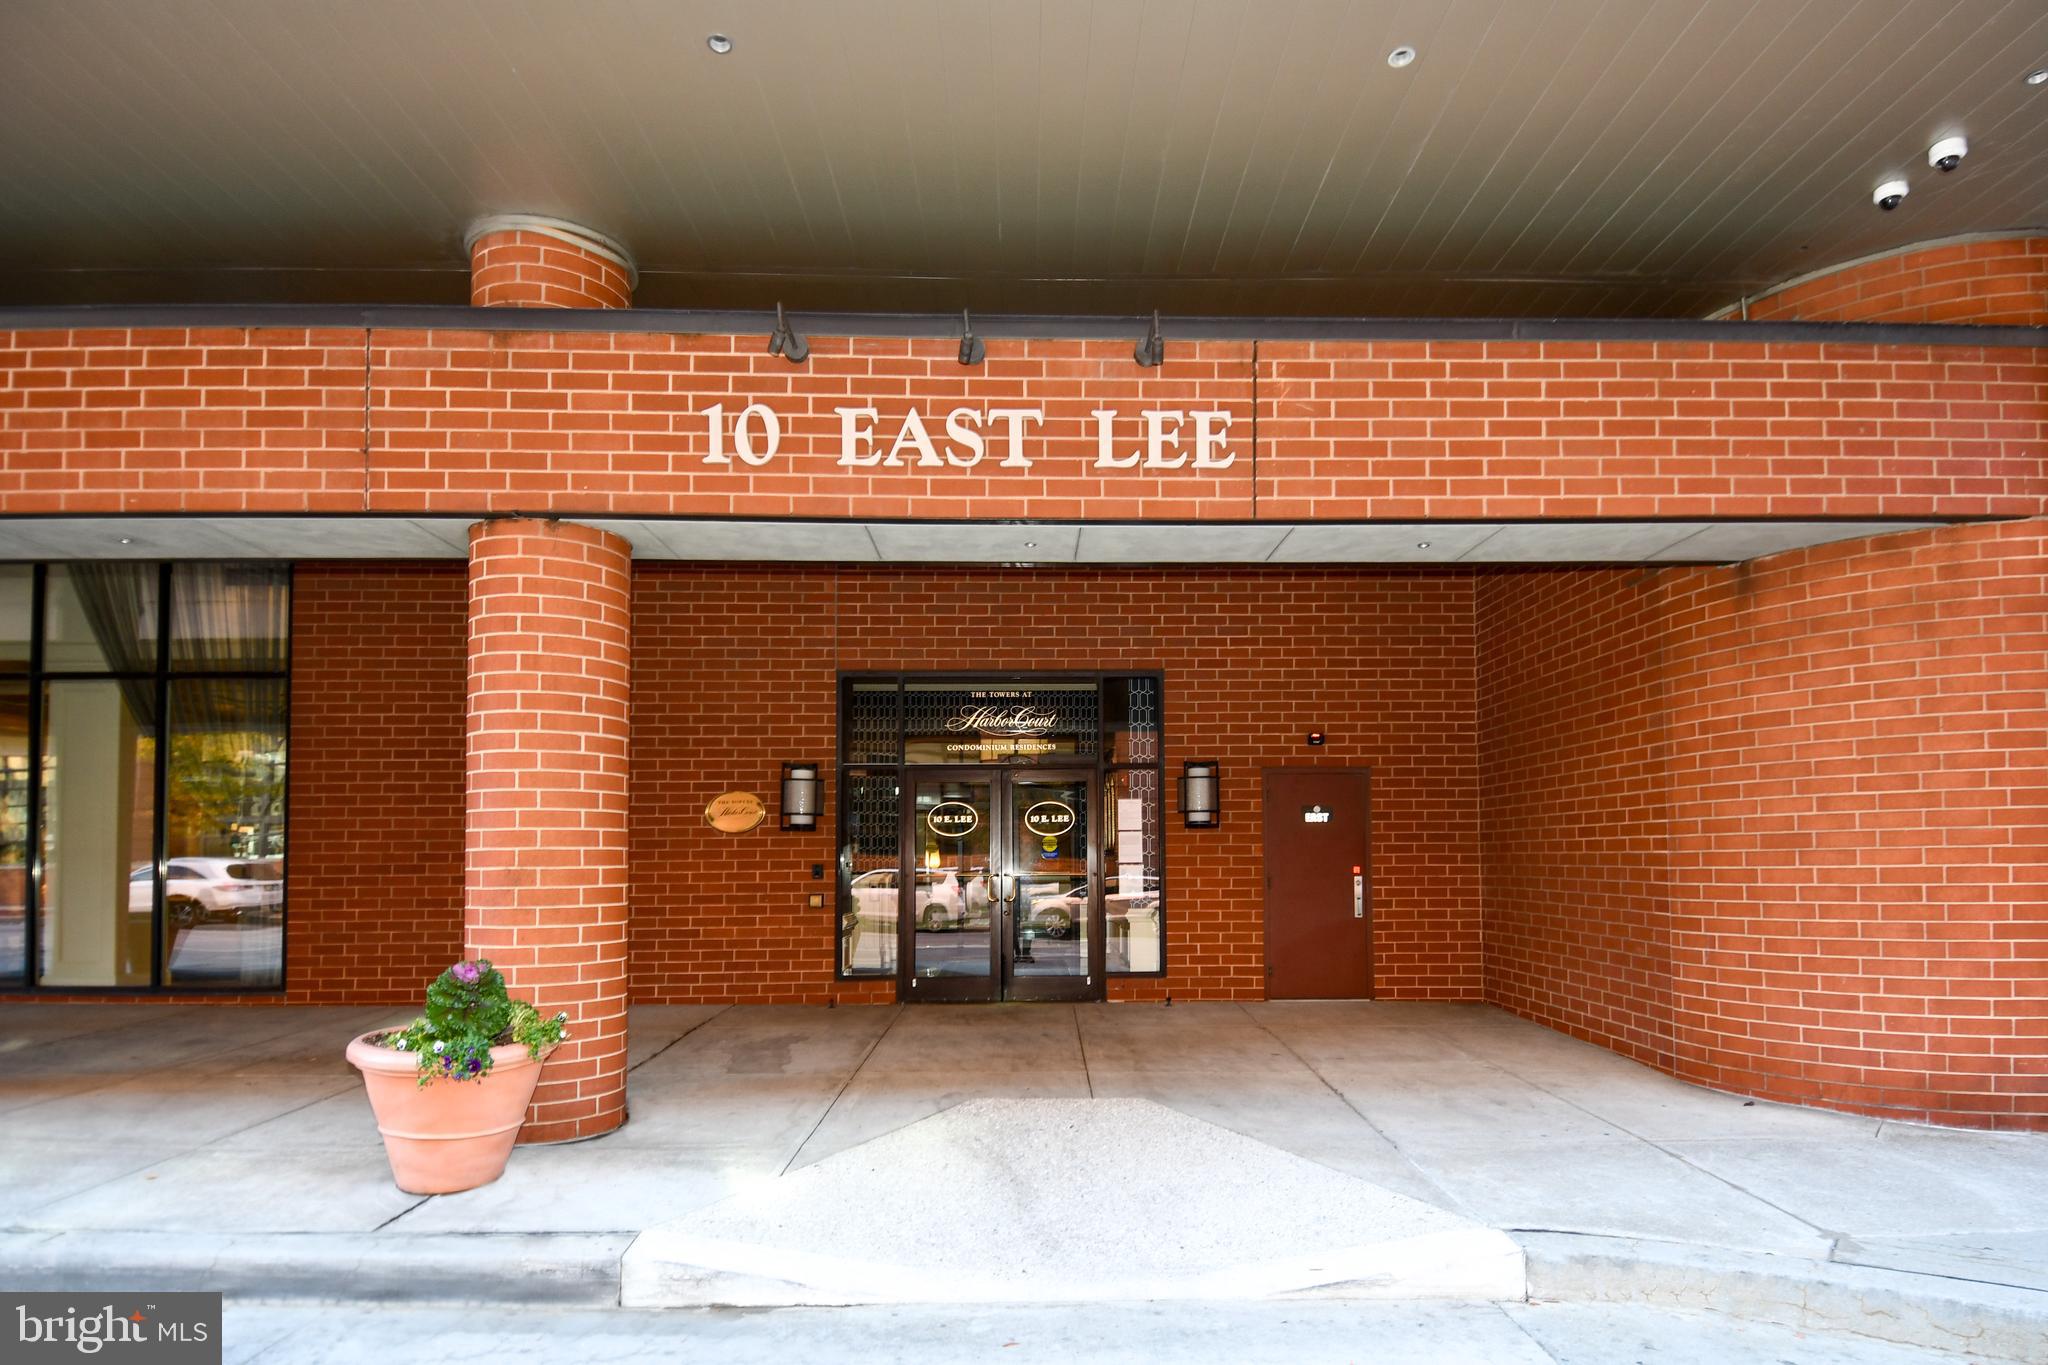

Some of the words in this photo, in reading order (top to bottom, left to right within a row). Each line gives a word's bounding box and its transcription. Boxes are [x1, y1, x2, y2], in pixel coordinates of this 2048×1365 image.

[700, 403, 780, 467] 10
[834, 406, 1045, 468] EAST
[1091, 409, 1236, 469] LEE
[1010, 743, 1056, 751] RESIDENCES
[933, 815, 942, 823] 10
[954, 815, 973, 823] LEE
[1030, 815, 1040, 823] 10
[1051, 815, 1070, 823] LEE
